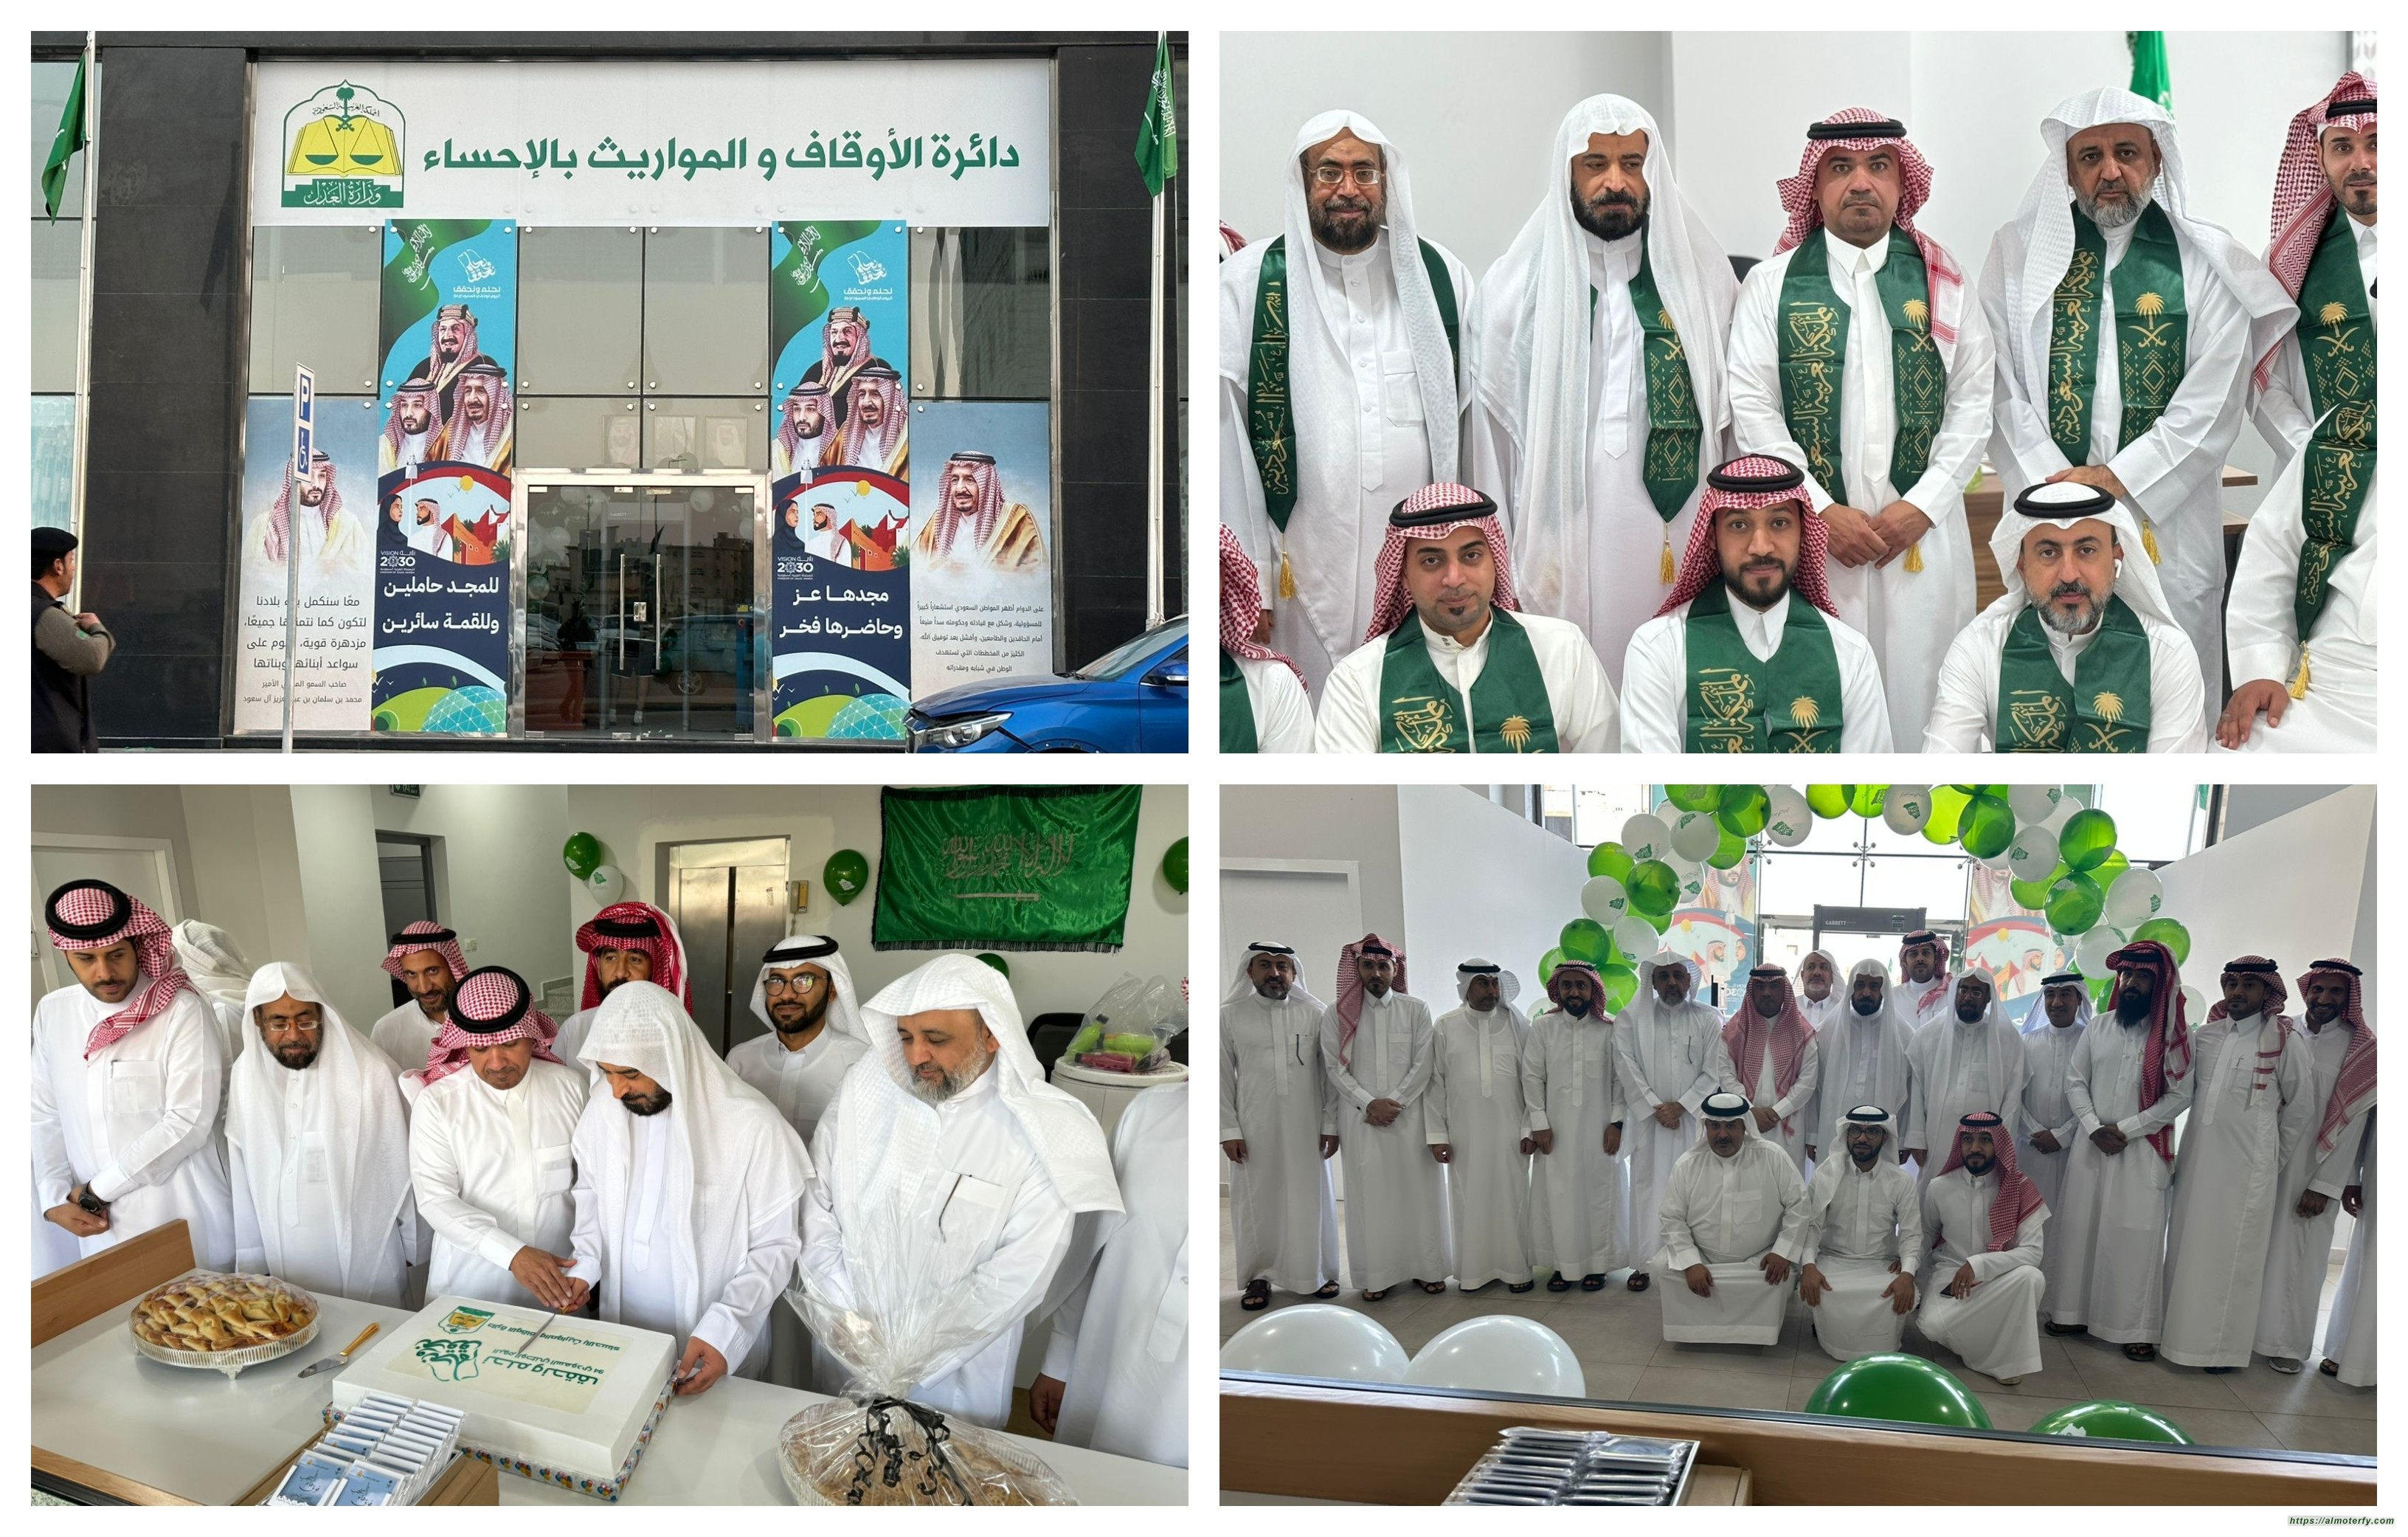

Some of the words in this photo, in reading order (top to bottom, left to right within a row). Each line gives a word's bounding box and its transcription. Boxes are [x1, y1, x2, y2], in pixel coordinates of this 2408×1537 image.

[423, 137, 578, 180] بالإحساء
[587, 136, 747, 182] المواريث
[785, 127, 922, 182] الأوقاف
[930, 132, 1020, 182] دائرة
[758, 148, 777, 182] و
[303, 180, 346, 206] العدل
[347, 180, 381, 205] وزارة
[300, 377, 310, 417] P
[384, 576, 443, 598] حاملين
[446, 576, 499, 598] للمجد
[256, 595, 280, 608] بلادنا
[304, 595, 339, 609] سنكمل
[792, 588, 822, 606] عز
[826, 585, 889, 606] مجدها
[955, 604, 978, 612] السعودي
[1001, 604, 1014, 612] أظهر
[318, 616, 333, 626] كما
[338, 617, 367, 629] لتكون
[382, 612, 439, 634] سائرين
[443, 612, 499, 635] وللقمة
[779, 615, 821, 638] فخر
[825, 618, 903, 639] وحاضرها
[996, 620, 1011, 628] وشكل
[246, 638, 267, 649] على
[331, 638, 366, 650] مزدهرة
[960, 633, 978, 642] وأفشل
[1031, 635, 1042, 643] أمام
[295, 656, 322, 671] أبنائه
[327, 658, 358, 671] سواعد
[986, 666, 995, 674] في
[261, 679, 279, 688] الأمير
[263, 694, 271, 704] آل
[312, 696, 333, 704] سلمان
[482, 1355, 532, 1370] نحلم
